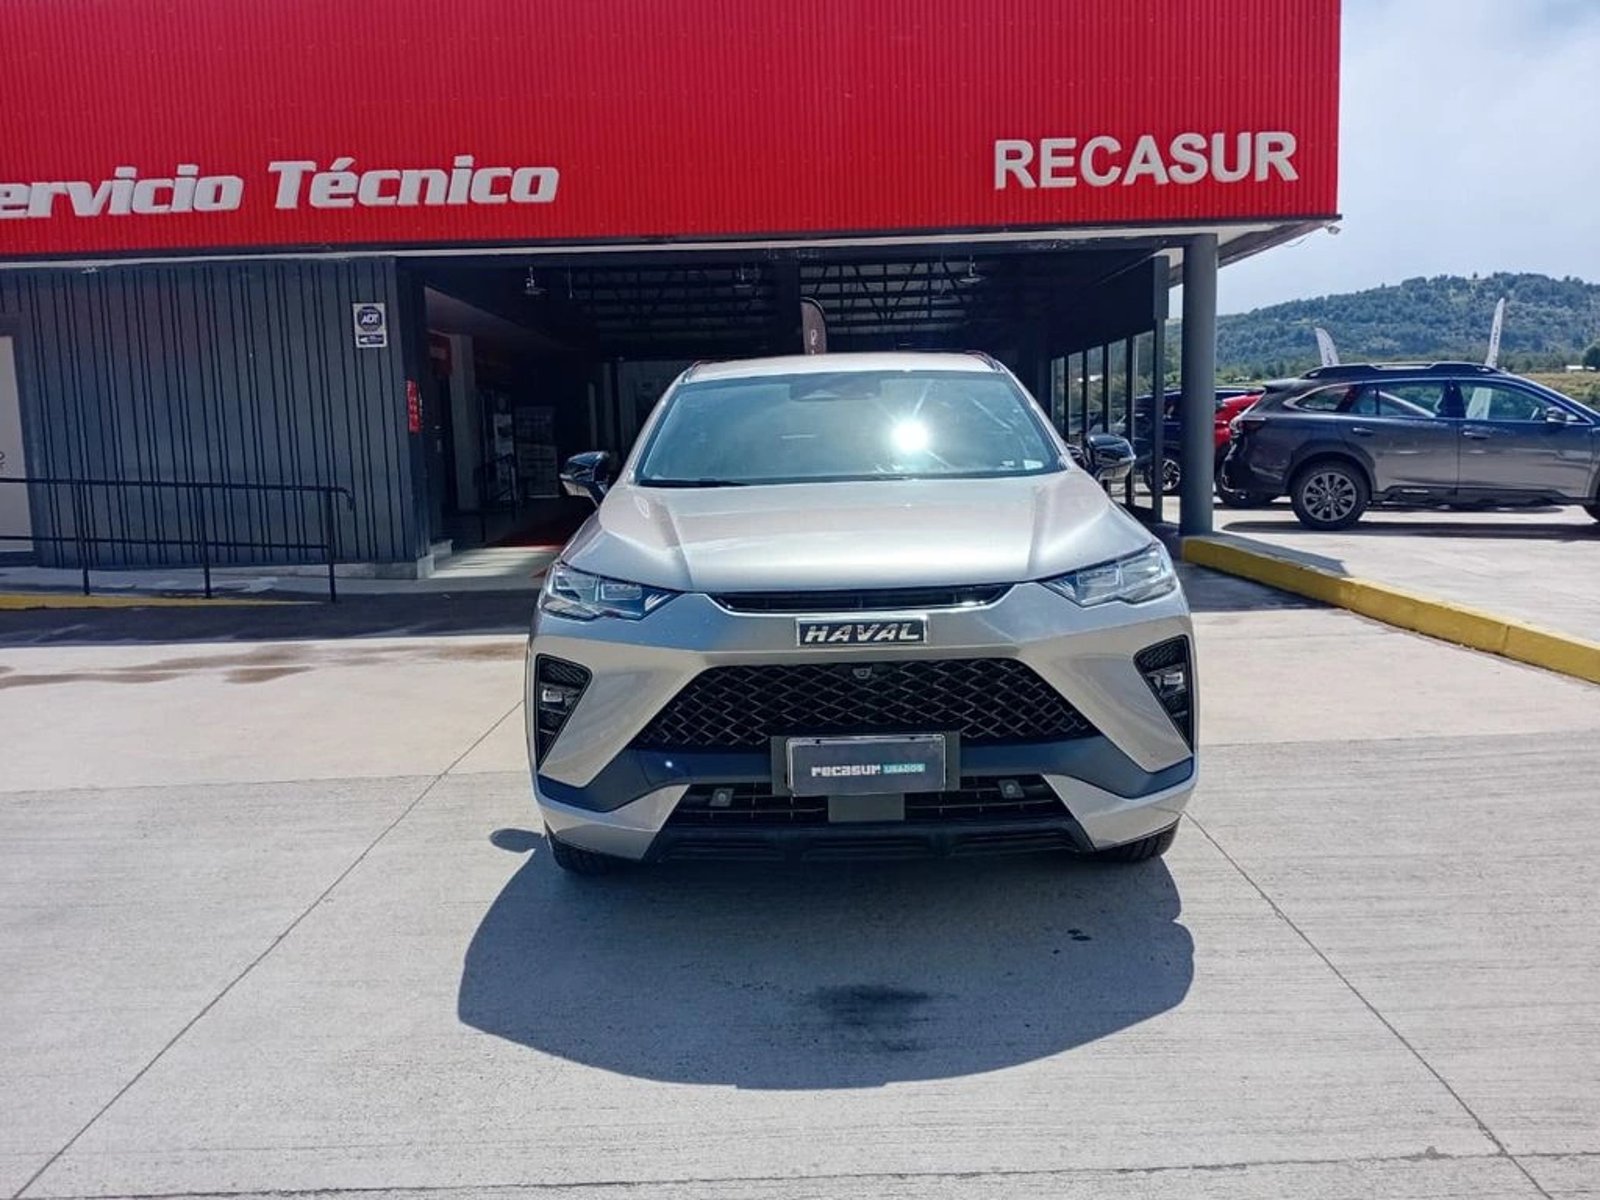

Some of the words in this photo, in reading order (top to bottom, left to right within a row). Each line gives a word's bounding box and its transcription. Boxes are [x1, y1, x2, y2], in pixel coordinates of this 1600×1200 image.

[267, 154, 560, 210] Técnico
[995, 131, 1299, 190] RECASUR
[804, 623, 920, 643] HAVAL
